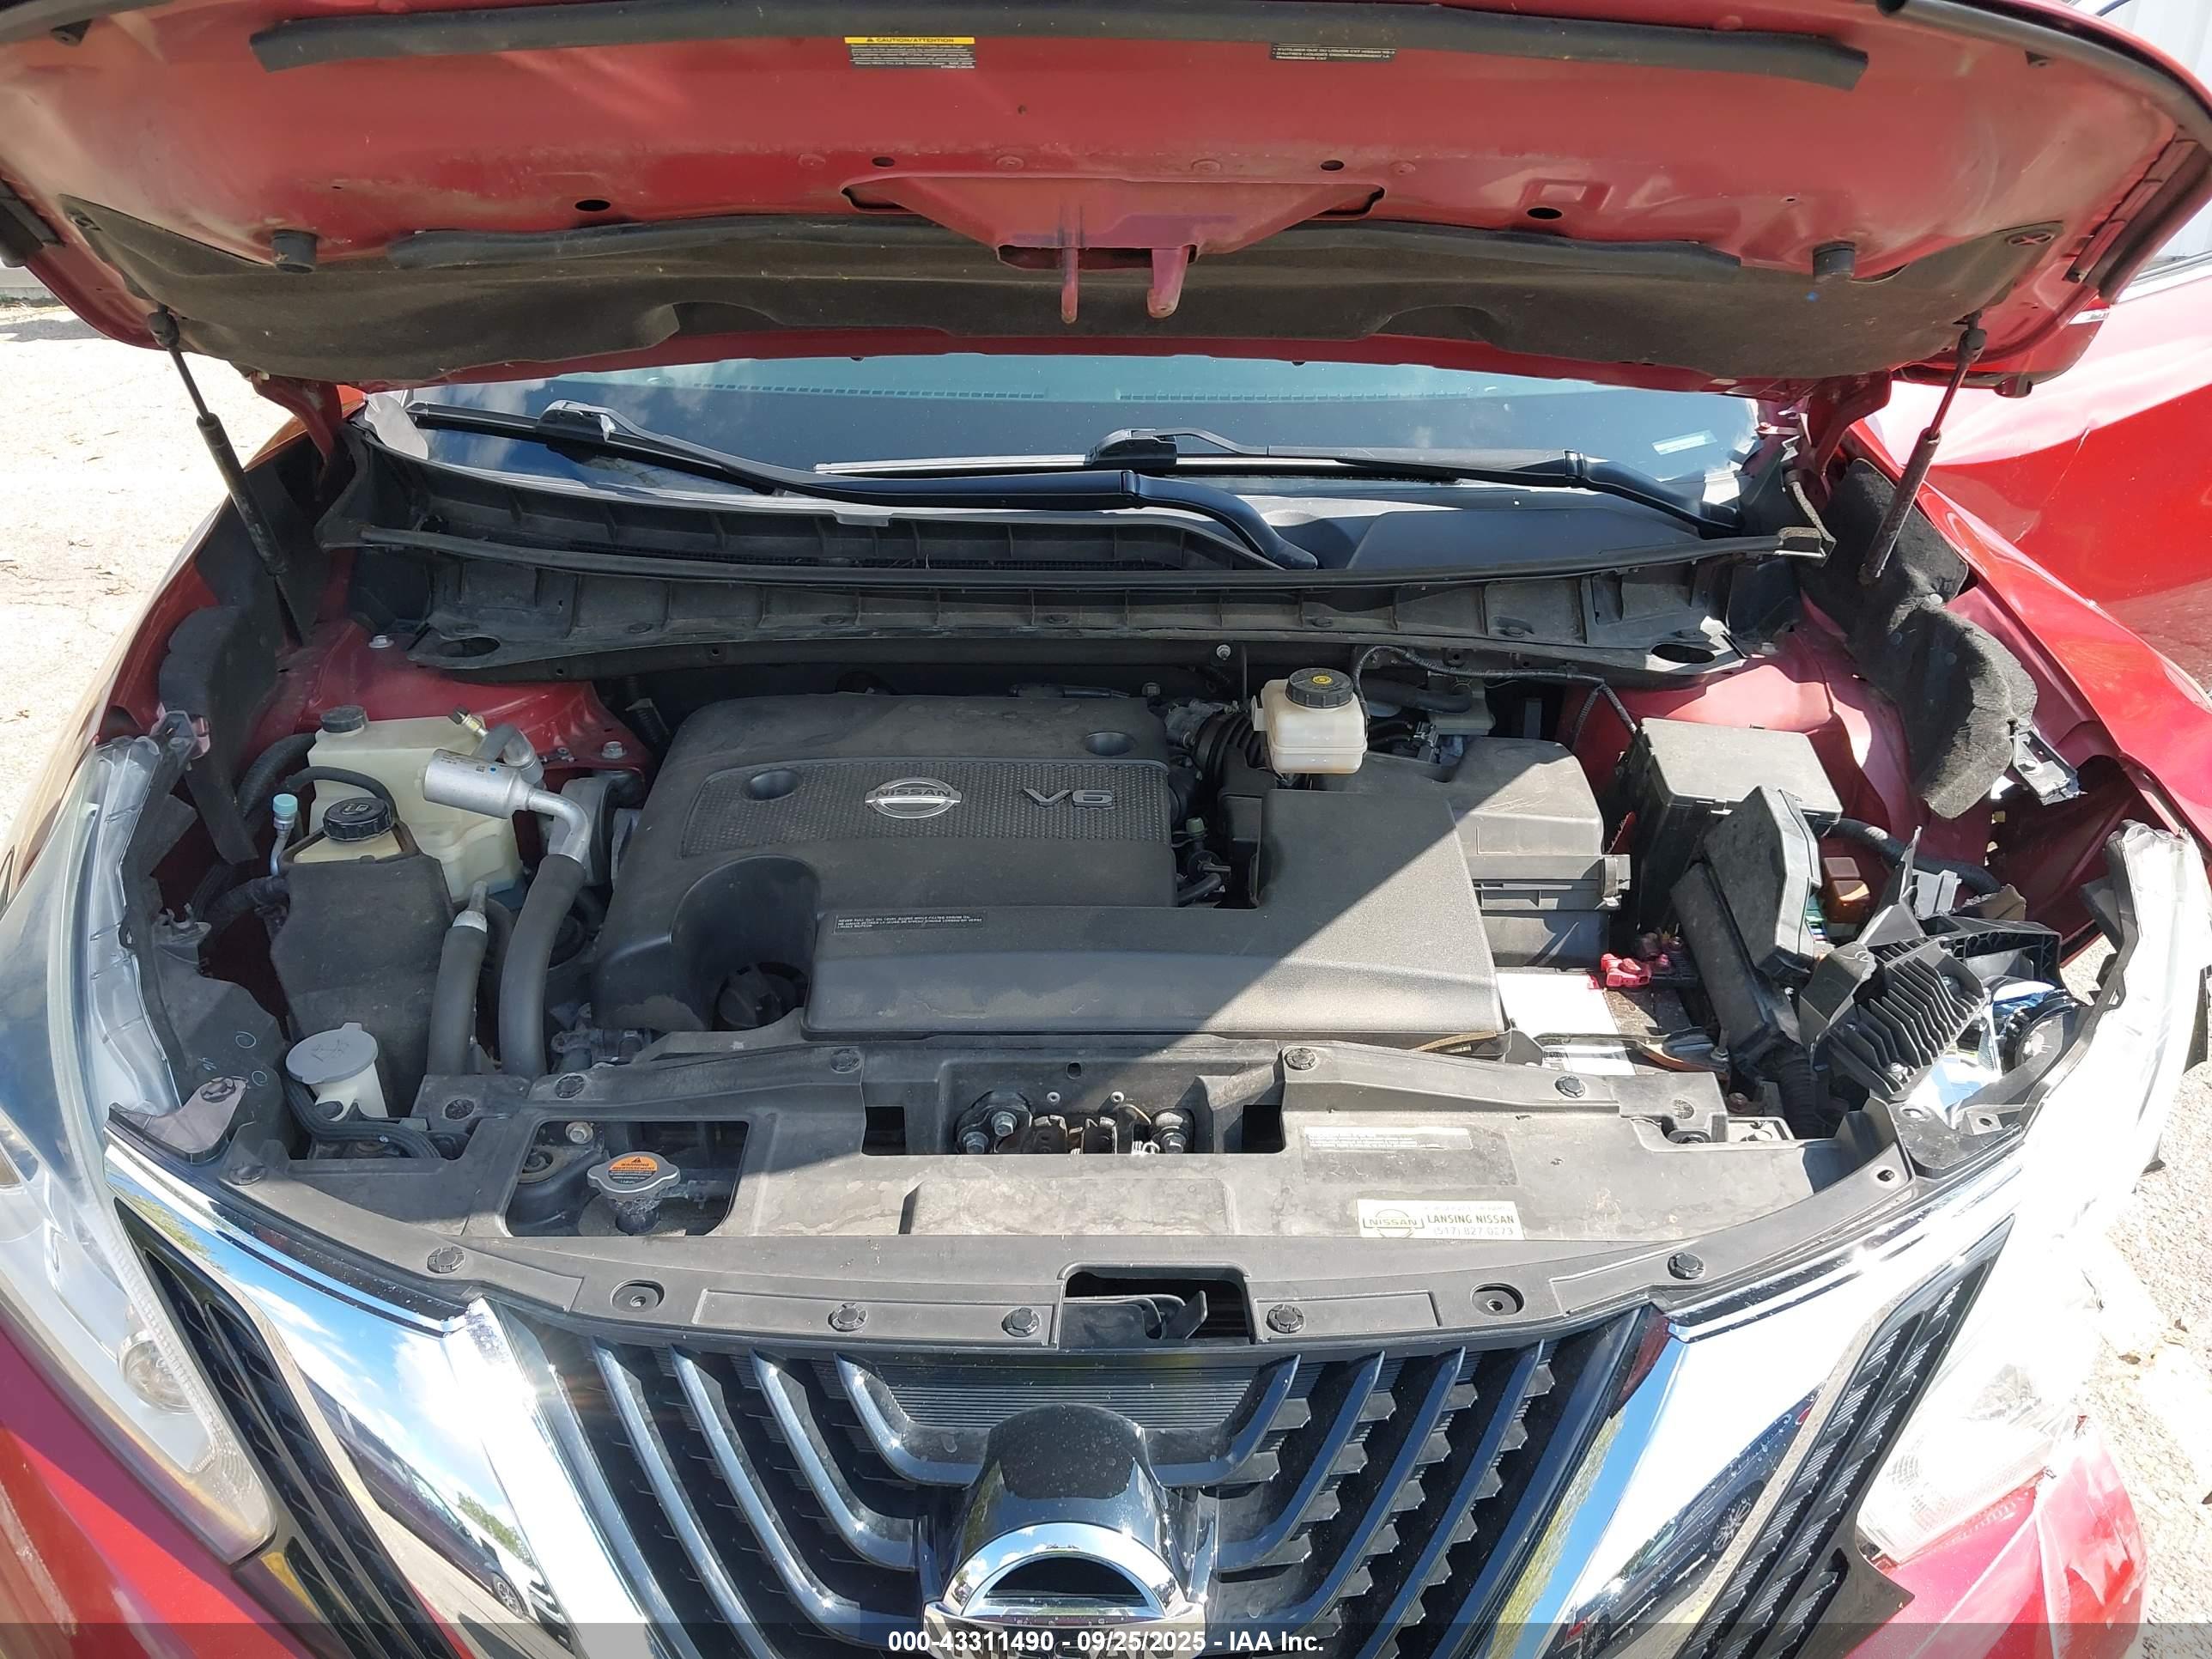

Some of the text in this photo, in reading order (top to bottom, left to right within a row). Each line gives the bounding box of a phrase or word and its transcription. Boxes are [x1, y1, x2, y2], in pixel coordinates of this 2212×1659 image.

[875, 788, 951, 798] NISSAN
[1020, 787, 1114, 809] V6
[1426, 1214, 1515, 1224] LANSING NISSAN
